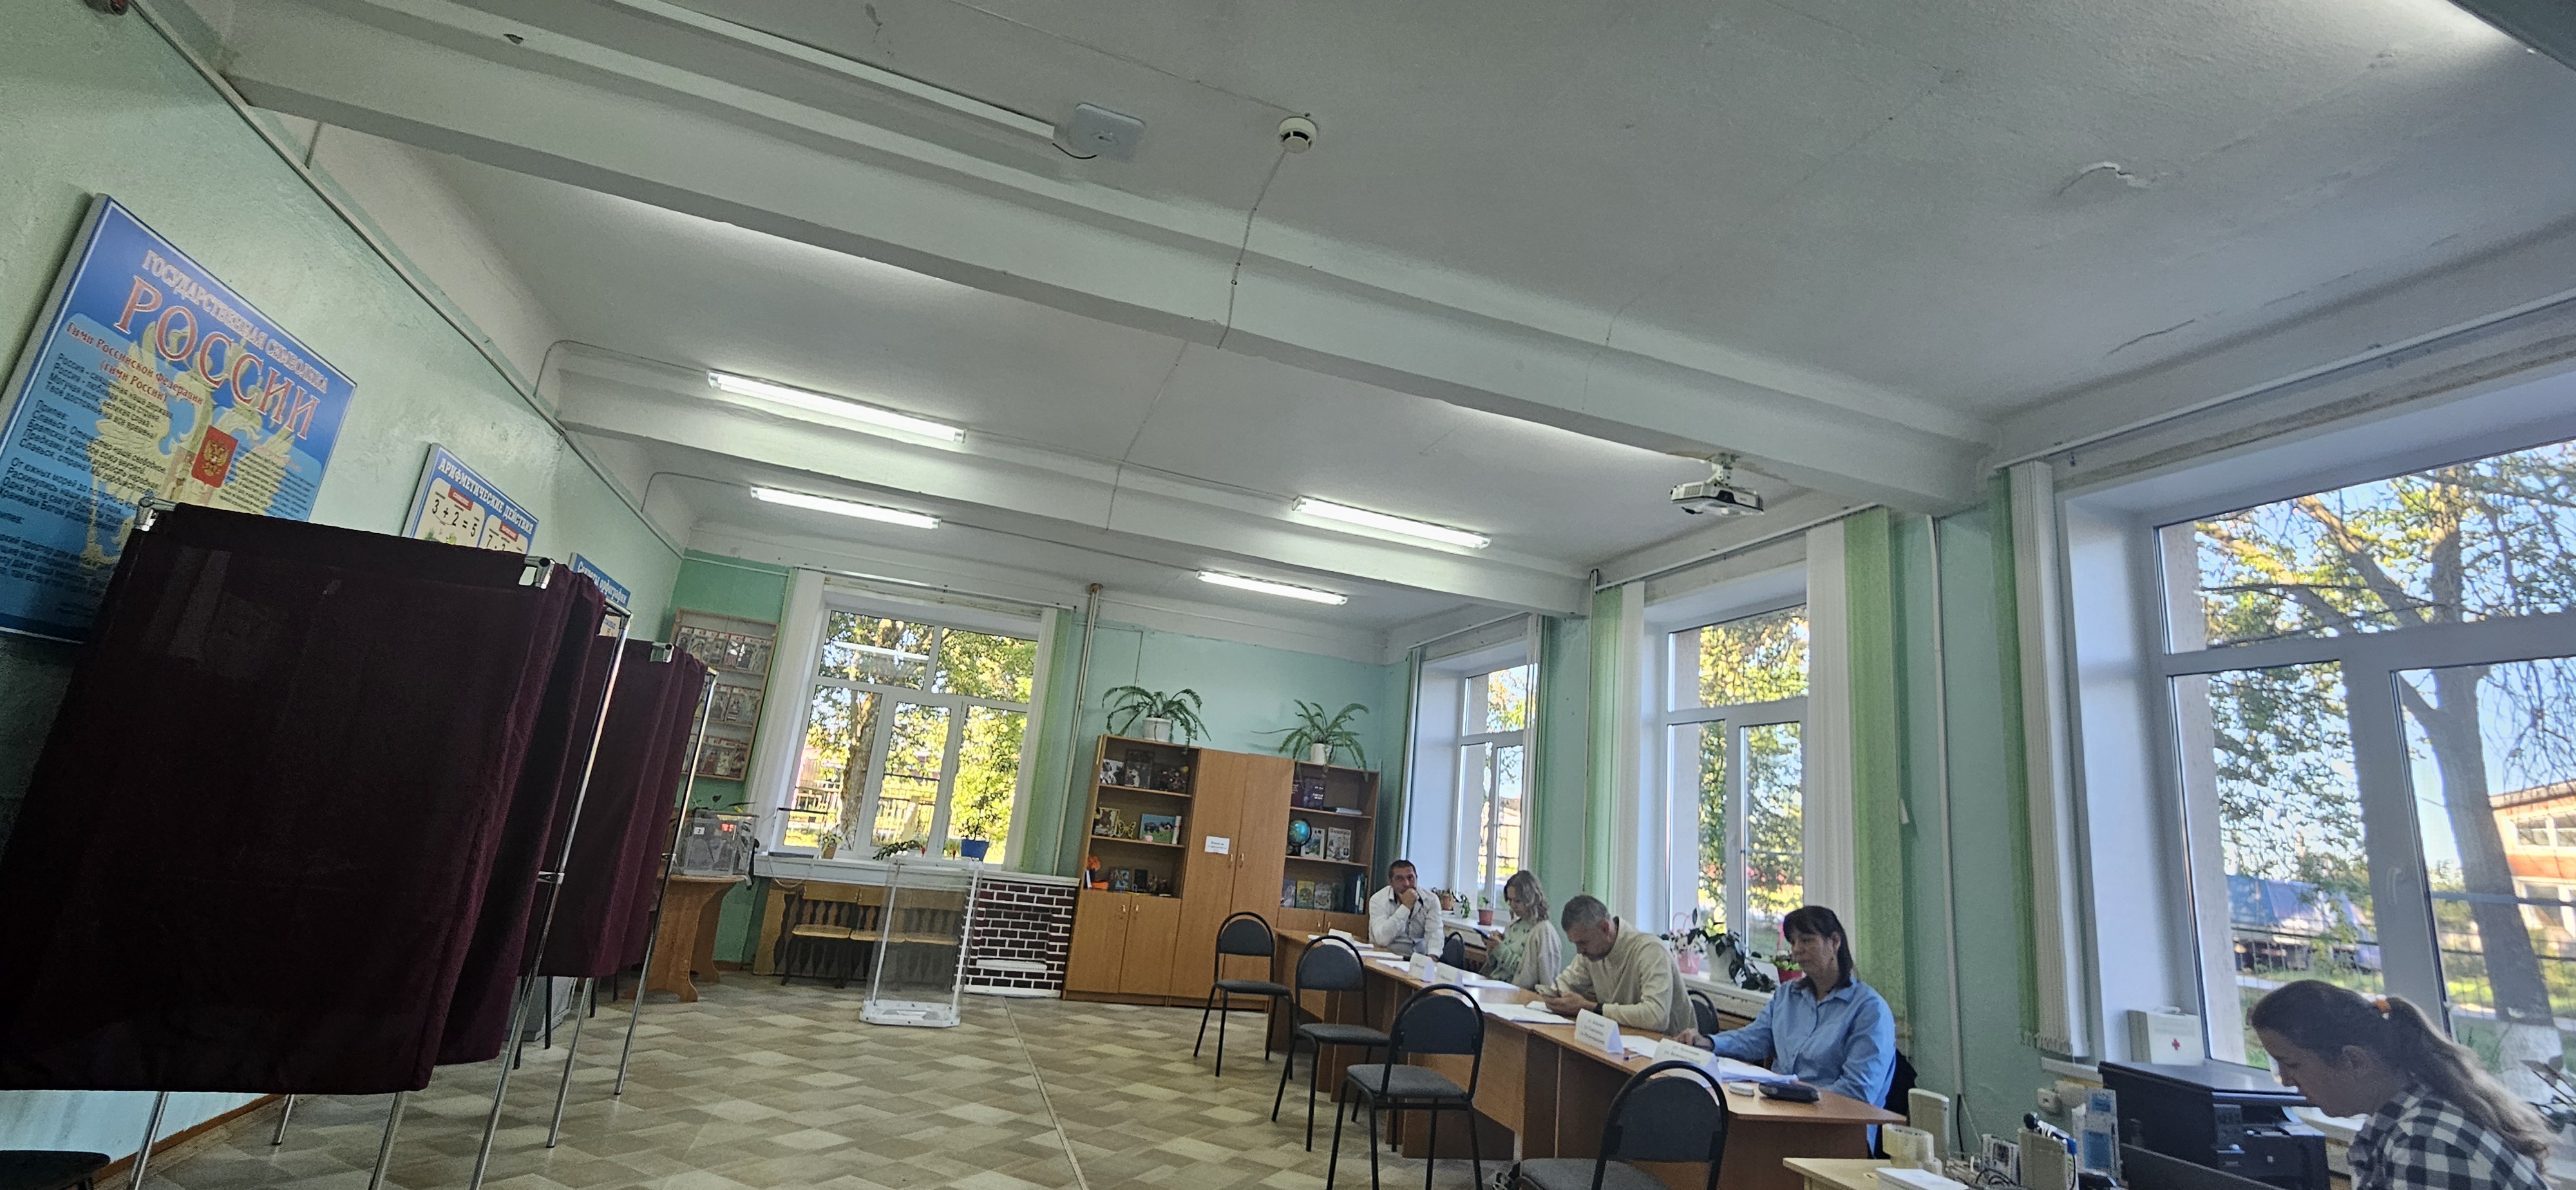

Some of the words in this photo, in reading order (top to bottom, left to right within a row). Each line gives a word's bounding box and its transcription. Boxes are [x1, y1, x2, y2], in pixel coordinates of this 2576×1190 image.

[142, 250, 269, 350] ГОСУДАРСТВЕННАЯ
[265, 339, 328, 393] СИМВОЛИКА
[52, 361, 82, 383] Россия
[57, 352, 86, 373] Россия
[66, 323, 95, 346] Гимн
[155, 371, 204, 405] Федерации
[113, 276, 320, 440] РОССИИ
[130, 375, 167, 403] России)
[438, 458, 505, 513] АРИФМЕТИЧЕСКИЕ
[502, 505, 534, 534] ДЕЙСТВИЯ
[432, 499, 440, 514] 3
[443, 507, 448, 518] +
[451, 512, 459, 527] 2
[462, 520, 468, 529] =
[471, 523, 477, 537] 5
[486, 534, 493, 548] 7
